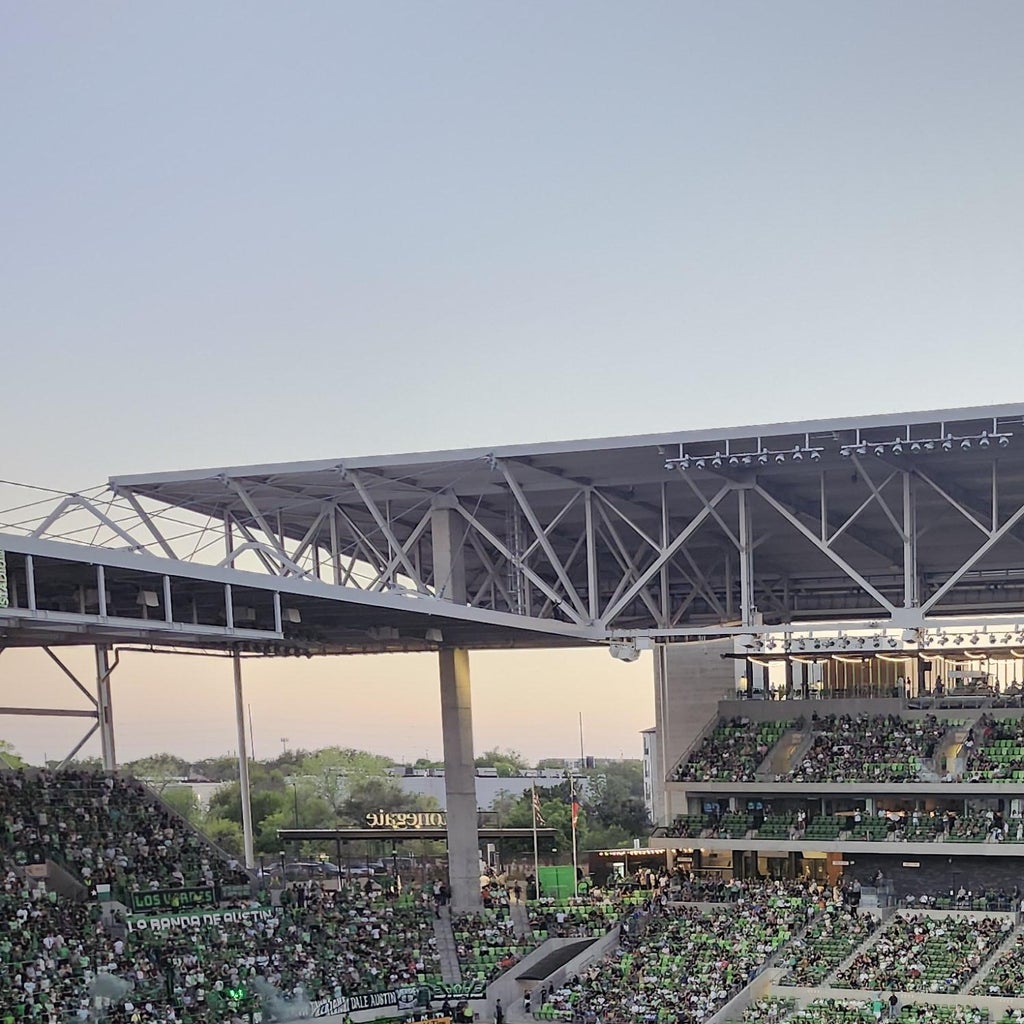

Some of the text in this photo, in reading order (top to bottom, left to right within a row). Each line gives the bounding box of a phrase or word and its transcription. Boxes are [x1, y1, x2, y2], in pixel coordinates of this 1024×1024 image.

[134, 895, 160, 907] LOS
[163, 890, 212, 906] VRDS
[150, 915, 201, 931] BANDA
[203, 913, 221, 927] DE
[223, 909, 272, 923] AUSTIN
[351, 995, 369, 1009] DALE
[370, 991, 396, 1006] AUSTIN
